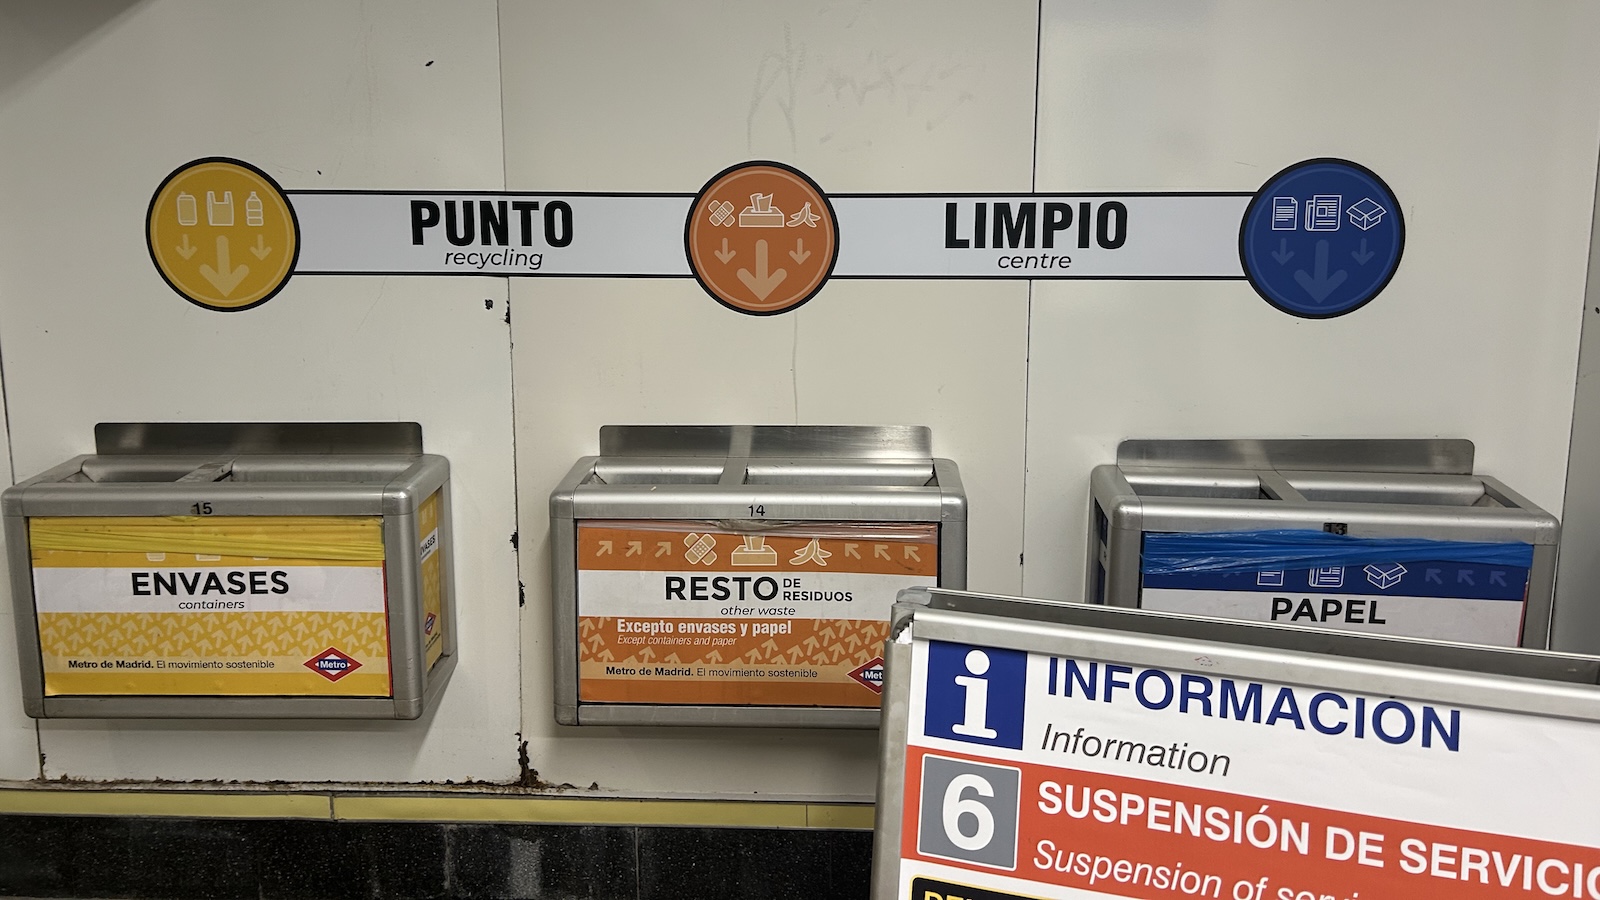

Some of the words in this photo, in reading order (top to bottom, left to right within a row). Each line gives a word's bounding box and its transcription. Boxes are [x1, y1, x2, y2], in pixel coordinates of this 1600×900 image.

[411, 200, 573, 247] PUNTO
[945, 201, 1127, 249] LIMPIO
[444, 249, 543, 271] recycling
[997, 253, 1072, 269] centre
[192, 502, 213, 515] 15
[748, 504, 766, 518] 14
[132, 571, 289, 596] ENVASES
[665, 576, 778, 601] RESTO
[783, 578, 801, 588] DE
[783, 591, 853, 602] RESIDUOS
[178, 598, 245, 610] containers
[721, 605, 754, 616] other
[759, 606, 796, 616] waste
[1271, 598, 1386, 624] PAPEL
[617, 618, 674, 636] Excepto
[677, 622, 737, 635] envases
[740, 624, 749, 637] y
[752, 619, 792, 637] papel
[617, 635, 646, 647] Except
[648, 636, 692, 646] containers
[694, 636, 711, 646] and
[712, 637, 738, 647] paper
[68, 660, 98, 670] Metro
[101, 660, 113, 669] de
[116, 660, 154, 669] Madrid.
[157, 660, 166, 669] El
[168, 660, 224, 669] movimiento
[226, 659, 275, 669] sostenible
[319, 660, 347, 670] Metro
[606, 667, 636, 676] Metro
[639, 667, 652, 676] de
[654, 667, 694, 677] Madrid.
[697, 668, 706, 677] El
[708, 668, 766, 677] movimiento
[768, 668, 818, 678] sostenible
[865, 669, 883, 681] Met
[1041, 723, 1231, 777] Information
[943, 773, 994, 851] 6
[1037, 780, 1310, 856] SUSPENSIÓN
[1325, 825, 1385, 868] DE
[1032, 839, 1223, 899] Suspension
[1233, 877, 1269, 900] of
